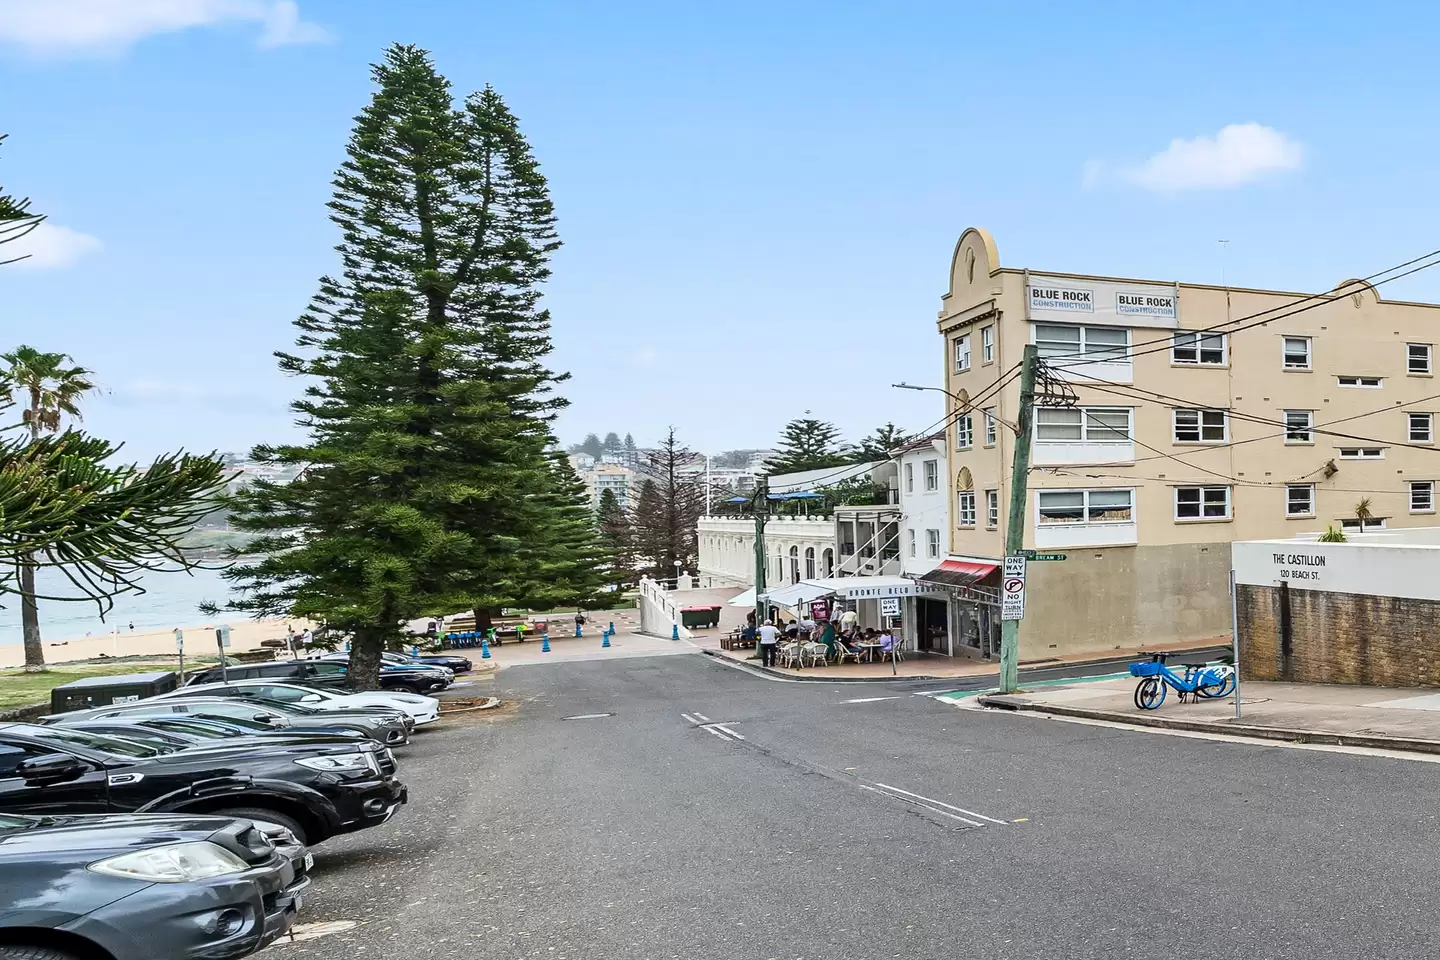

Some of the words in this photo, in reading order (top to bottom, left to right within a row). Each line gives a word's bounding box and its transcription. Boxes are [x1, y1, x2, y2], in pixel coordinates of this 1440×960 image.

[1032, 289, 1060, 300] BLUE
[1062, 291, 1091, 302] ROCK
[1119, 295, 1143, 306] BLUE
[1146, 297, 1172, 307] ROCK
[1032, 299, 1092, 310] CONSTRUCTION
[1119, 305, 1173, 315] CONSTRUCTION
[1272, 553, 1285, 564] THE
[1287, 554, 1326, 566] CASTILLON
[1280, 569, 1289, 578] 120
[1291, 570, 1310, 580] BEACH
[1311, 571, 1320, 580] ST.
